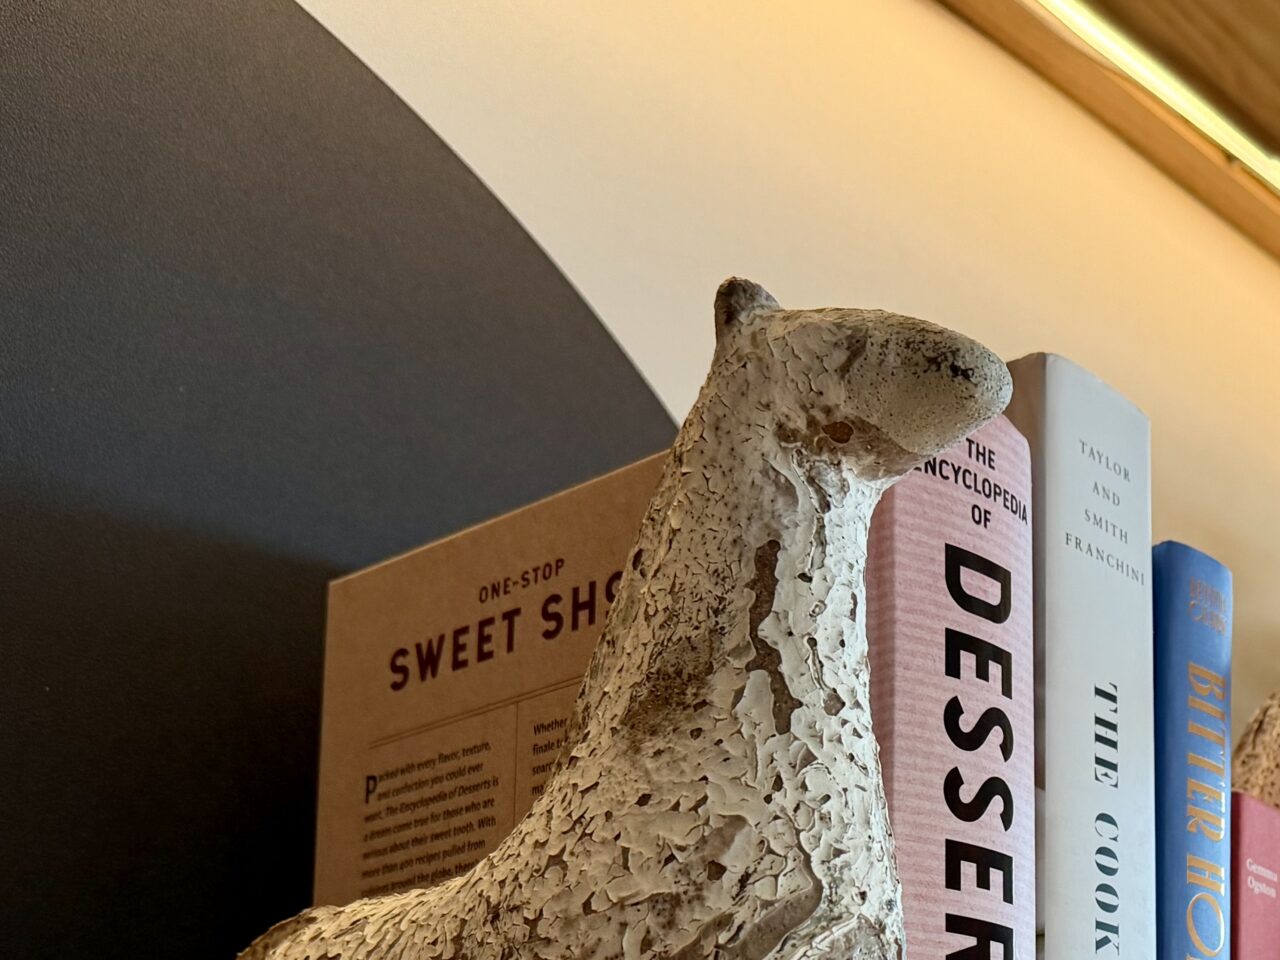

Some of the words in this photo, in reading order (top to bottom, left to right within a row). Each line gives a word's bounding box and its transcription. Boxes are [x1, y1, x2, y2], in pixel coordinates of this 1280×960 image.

[966, 438, 996, 471] THE
[1079, 440, 1131, 482] TAYLOR
[912, 457, 1028, 526] NCYCLOPEDIA
[1092, 481, 1121, 507] AND
[971, 504, 992, 529] OF
[1084, 509, 1129, 545] SMITH
[1065, 532, 1146, 586] FRANCHINI
[479, 558, 565, 604] ONE-STOP
[389, 608, 522, 692] SWEET
[540, 571, 624, 640] SHO
[533, 718, 568, 736] Whether
[1094, 682, 1119, 789] THE
[532, 739, 556, 756] finale
[1186, 661, 1226, 843] BITTER
[416, 758, 437, 771] every
[430, 776, 445, 788] you
[445, 766, 467, 781] could
[467, 762, 484, 775] ever
[384, 805, 399, 817] The
[399, 792, 448, 814] Encyclopedia
[448, 786, 458, 800] of
[458, 780, 491, 798] Desserts
[413, 816, 429, 828] true
[430, 811, 442, 823] for
[442, 805, 464, 820] those
[464, 800, 481, 814] who
[481, 797, 496, 810] are
[411, 833, 429, 847] their
[430, 828, 453, 842] sweet
[477, 816, 497, 830] With
[415, 850, 441, 867] recipes
[442, 843, 466, 860] pulled
[466, 838, 486, 853] from
[416, 871, 430, 883] the
